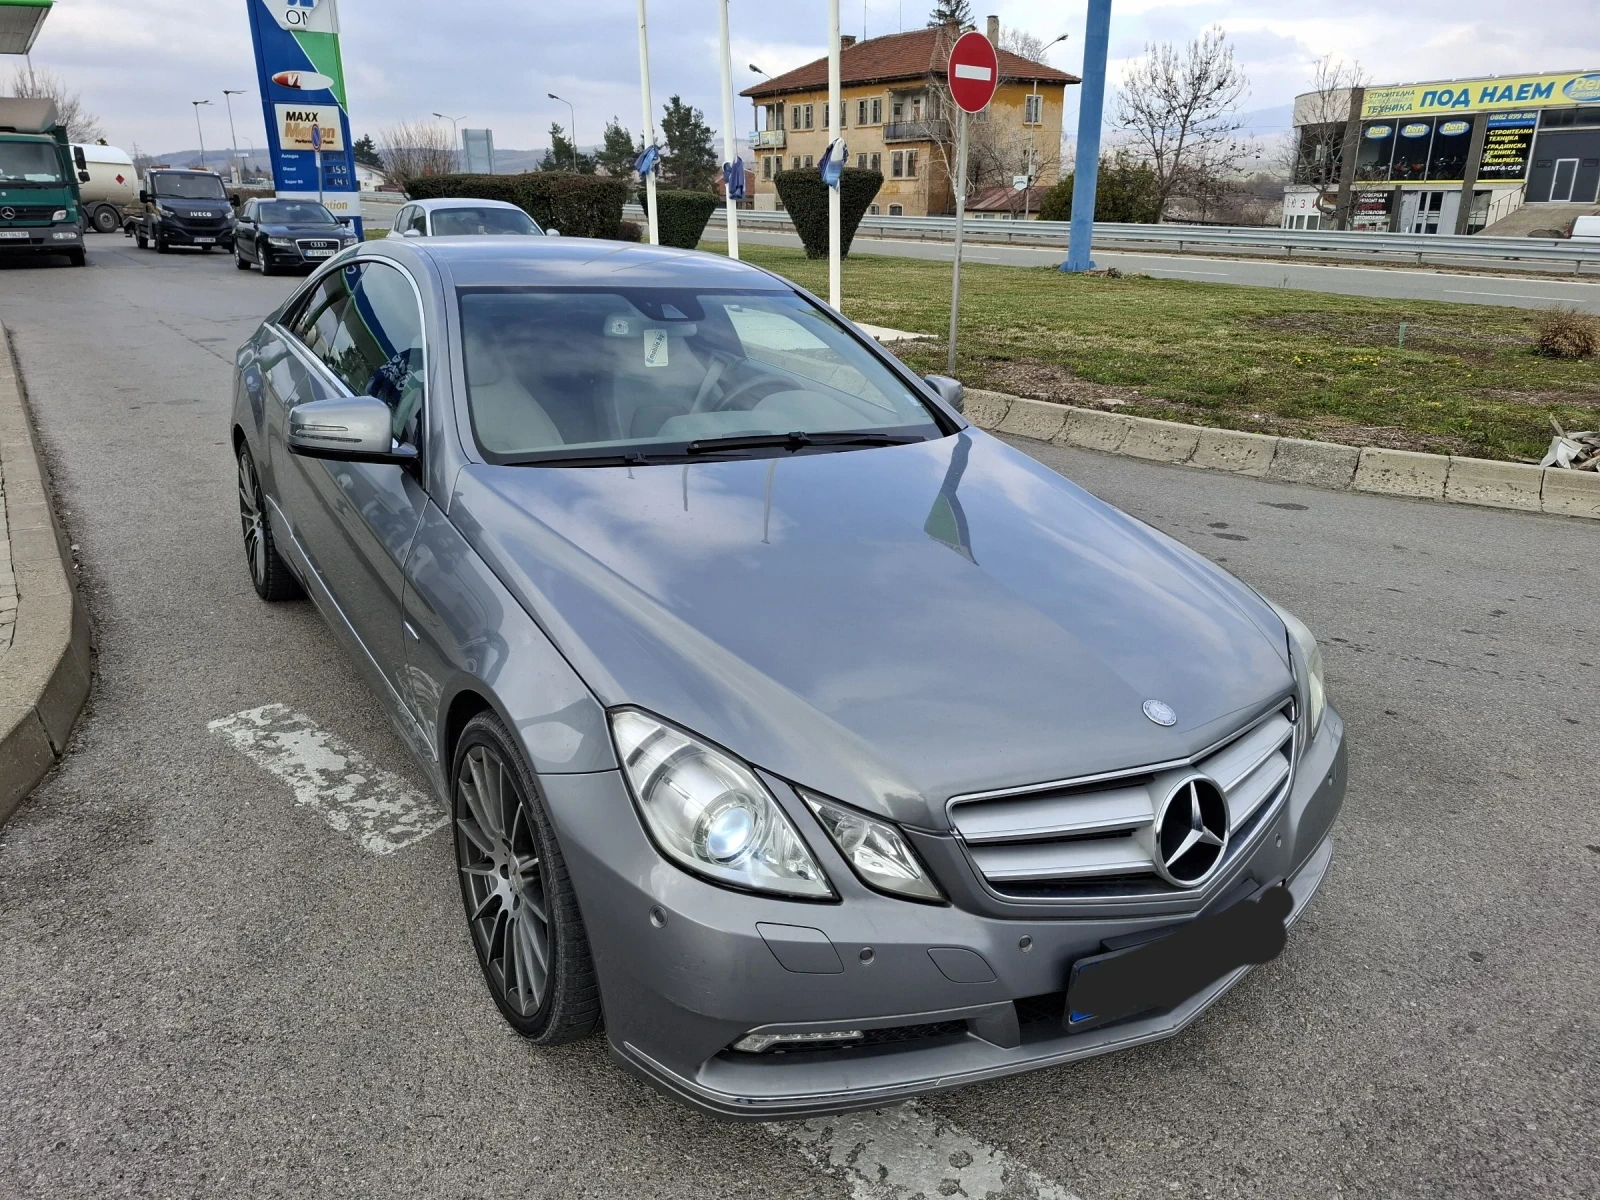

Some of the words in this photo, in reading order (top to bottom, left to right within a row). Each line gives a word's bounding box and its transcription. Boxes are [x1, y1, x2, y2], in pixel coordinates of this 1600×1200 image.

[1369, 89, 1415, 99] СТРОИТЕЛНА
[1420, 88, 1471, 108] ПОД
[1478, 81, 1555, 104] НАЕМ
[1367, 103, 1413, 114] ТЕХНИКА
[286, 111, 318, 122] MAXX
[1369, 126, 1388, 135] Rent
[1405, 124, 1426, 133] Rent
[1443, 122, 1465, 131] Rent
[649, 331, 665, 360] mobile.bg
